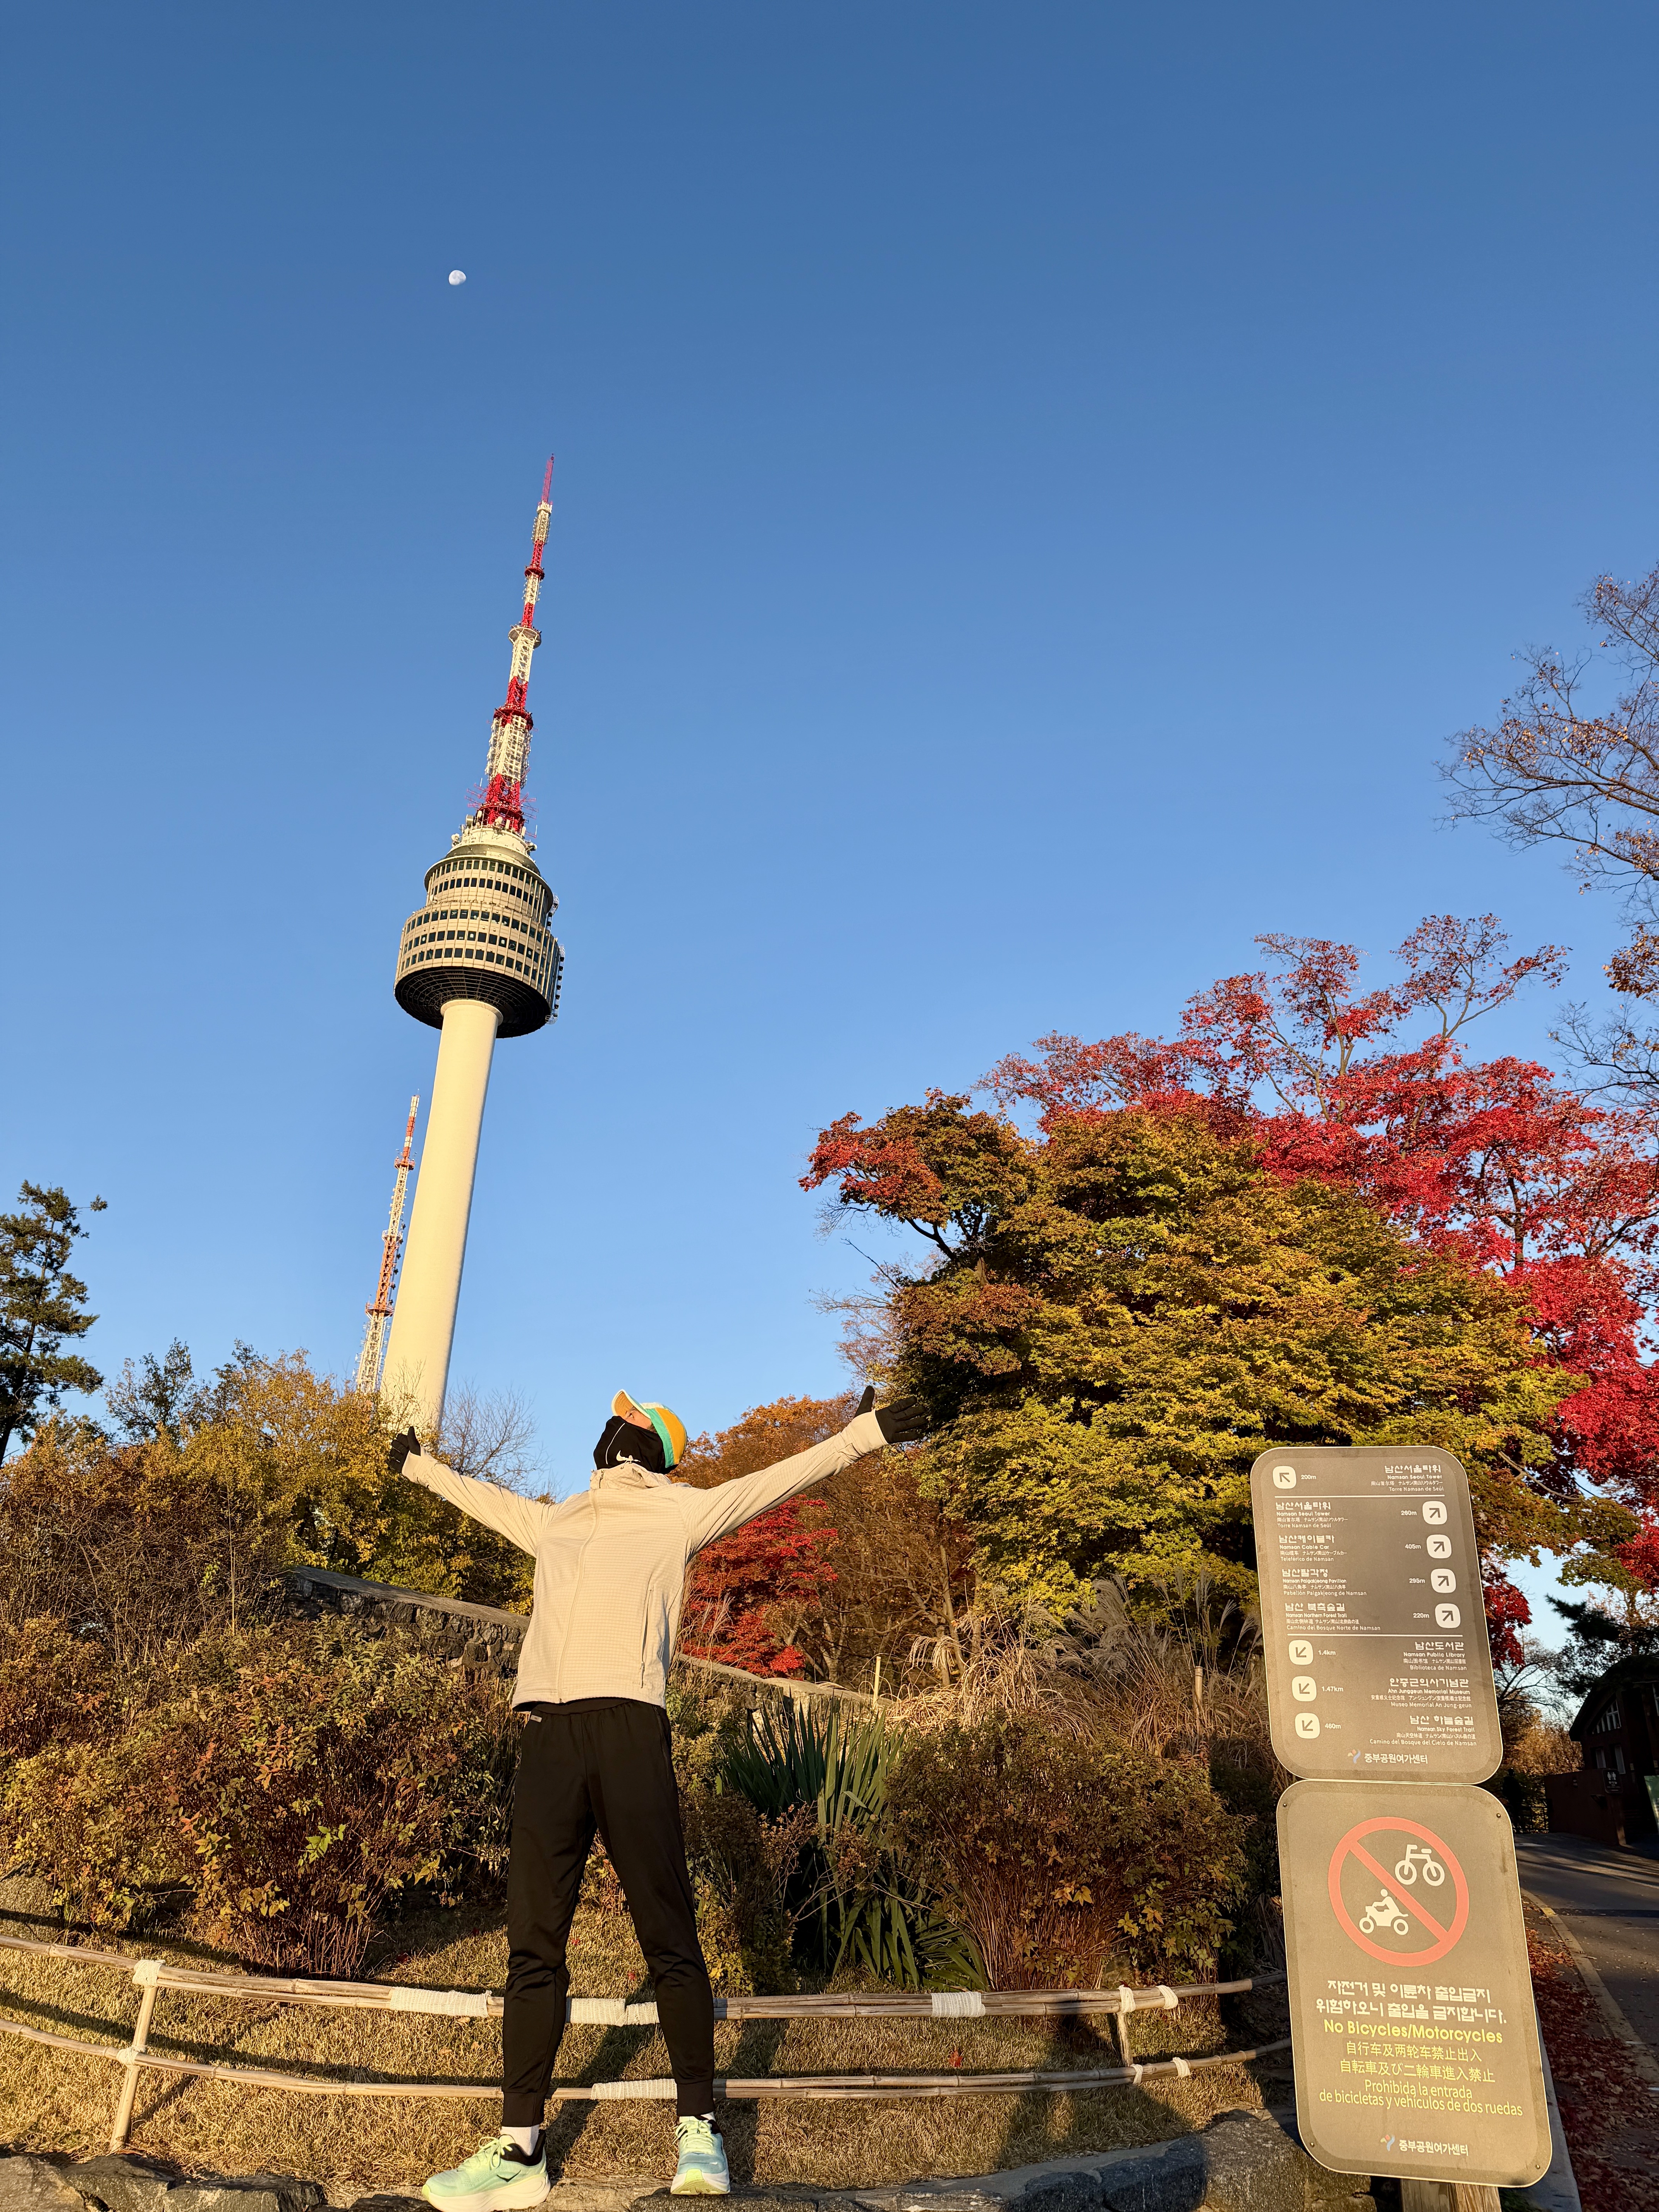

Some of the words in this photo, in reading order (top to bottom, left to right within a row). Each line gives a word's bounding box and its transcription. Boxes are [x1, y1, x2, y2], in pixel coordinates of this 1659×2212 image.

[1384, 1465, 1441, 1473] 남산서울타워
[1276, 1501, 1331, 1510] 남산서울타워
[1279, 1535, 1334, 1543] 남산케이블카
[1282, 1569, 1328, 1578] 남산팔각정
[1285, 1603, 1304, 1611] 남산
[1308, 1602, 1345, 1611] 북측숲길
[1415, 1642, 1464, 1650] 남산도서관
[1390, 1678, 1469, 1688] 안중근의사기념관
[1410, 1716, 1429, 1724] 남산
[1434, 1716, 1474, 1725] 하늘숲길
[1364, 1753, 1428, 1764] 중부공원여가센터
[1327, 1980, 1368, 1996] 자전거
[1372, 1982, 1386, 1997] 및
[1390, 1983, 1431, 2000] 이륜차
[1434, 1986, 1491, 2003] 출입금지
[1317, 1998, 1384, 2016] 위험하오니
[1388, 2002, 1429, 2019] 출입을
[1432, 2005, 1507, 2024] 금지합니다.
[1324, 2019, 1344, 2033] No
[1348, 2021, 1503, 2043] Bicycles/Motorcycles
[1346, 2040, 1482, 2062] 自行车及两轮车禁止出入
[1340, 2059, 1495, 2083] 自転車及び二輪車進入禁止
[1364, 2079, 1416, 2095] Prohibida
[1417, 2083, 1428, 2096] la
[1430, 2085, 1473, 2099] entrada
[1319, 2088, 1333, 2102] de
[1335, 2090, 1384, 2106] bicicletas
[1386, 2096, 1392, 2109] y
[1394, 2094, 1444, 2111] vehículos
[1447, 2098, 1460, 2112] de
[1463, 2099, 1483, 2114] dos
[1485, 2102, 1523, 2116] ruedas
[1399, 2140, 1469, 2157] 중부공원여가센터
